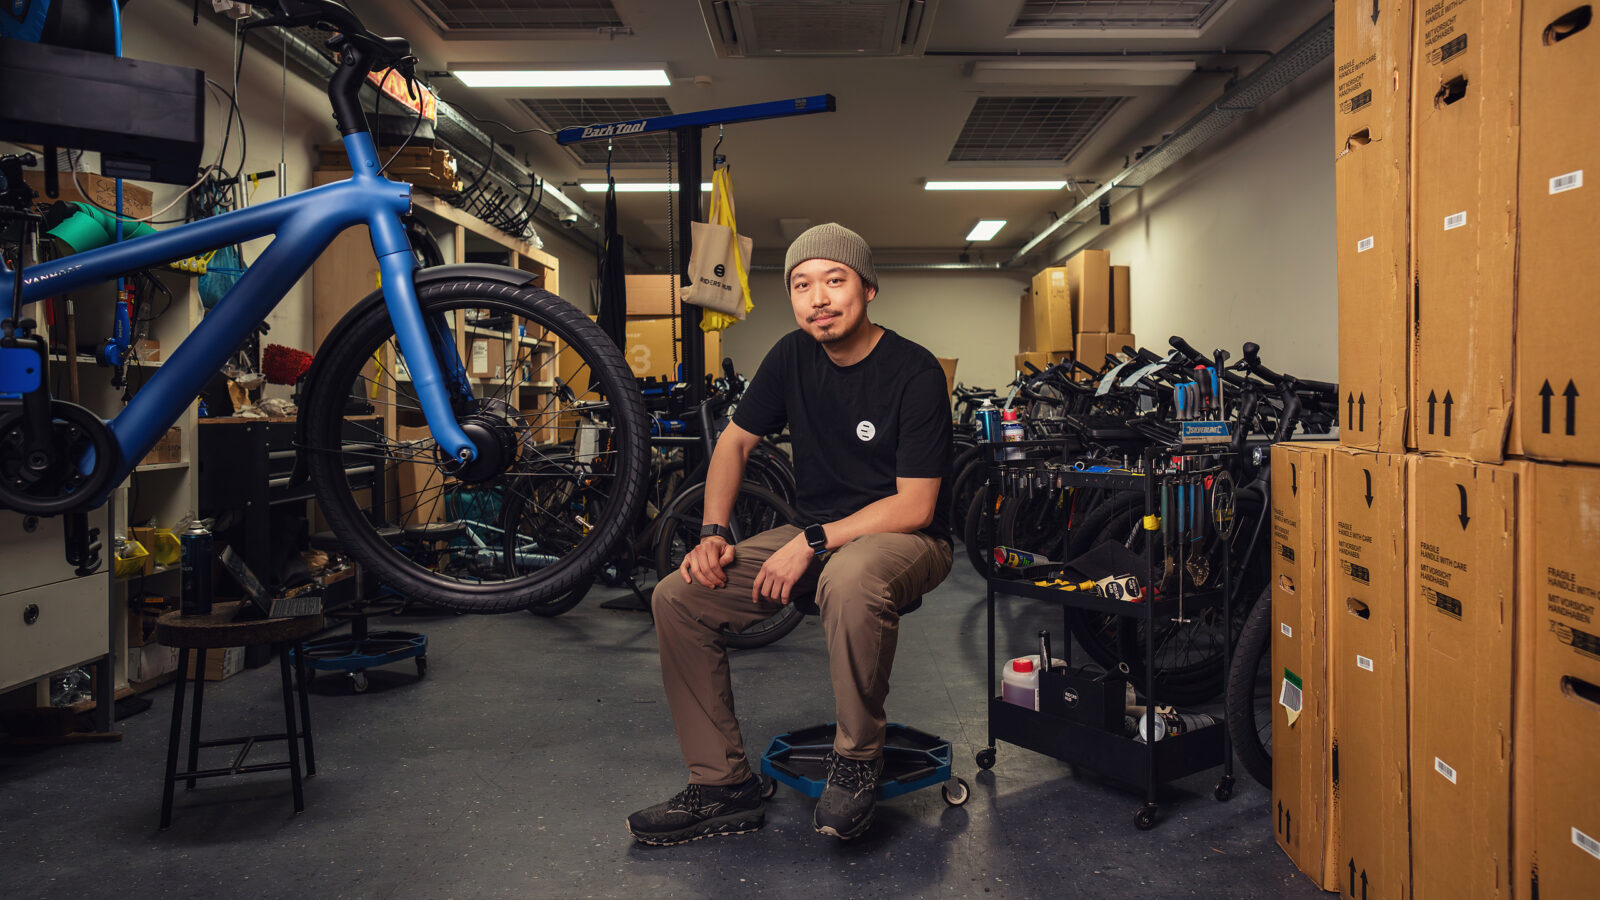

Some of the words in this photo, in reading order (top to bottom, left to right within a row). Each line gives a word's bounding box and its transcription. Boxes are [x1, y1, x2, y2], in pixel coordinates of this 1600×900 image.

[1425, 0, 1444, 17] FRAGILE
[1425, 8, 1444, 25] HANDLE
[1339, 59, 1354, 72] FRAGILE
[1339, 66, 1354, 80] HANDLE
[1366, 53, 1376, 65] CARE
[582, 125, 615, 138] Park
[616, 120, 647, 134] Tool
[24, 264, 82, 284] VANM
[700, 276, 721, 288] RIDERS
[631, 344, 651, 374] 3
[1338, 521, 1352, 531] FRAGILE
[1338, 528, 1352, 538] HANDLE
[1362, 535, 1372, 543] CARE
[1421, 541, 1439, 555] FRAGILE
[1421, 549, 1439, 562] HANDLE
[1440, 556, 1453, 567] WITH
[1454, 560, 1467, 573] CARE
[1421, 563, 1429, 572] MIT
[1429, 566, 1451, 580] VORSICHT
[1421, 571, 1448, 588] HANDHABEN
[1548, 566, 1576, 582] FRAGILE
[1548, 576, 1576, 592] HANDLE
[1577, 585, 1596, 598] WITH
[1548, 593, 1560, 604] MIT
[1561, 599, 1595, 615] VORSICHT
[1548, 603, 1591, 624] HANDHABEN
